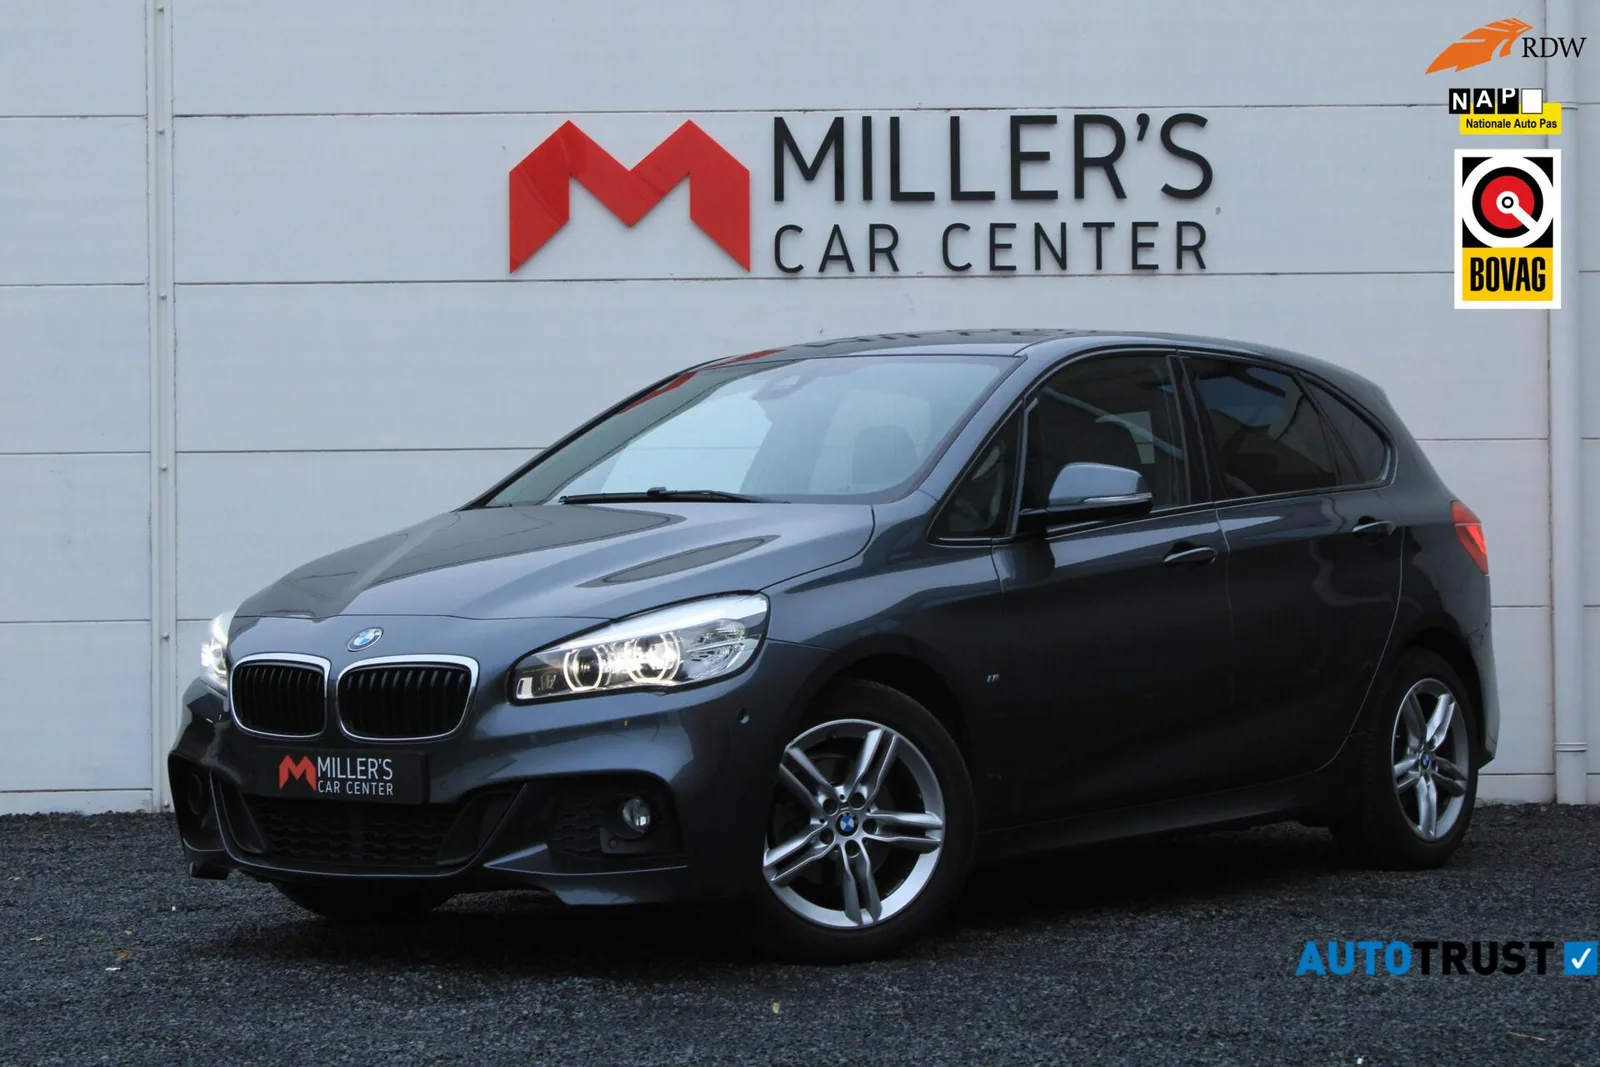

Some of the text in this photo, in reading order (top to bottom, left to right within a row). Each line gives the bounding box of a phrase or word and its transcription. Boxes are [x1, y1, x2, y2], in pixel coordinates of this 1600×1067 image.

[773, 113, 1213, 202] MILLER'S
[773, 221, 1208, 274] CAR CENTER
[317, 756, 393, 780] MILLER'S
[317, 780, 393, 795] CAR CENTER
